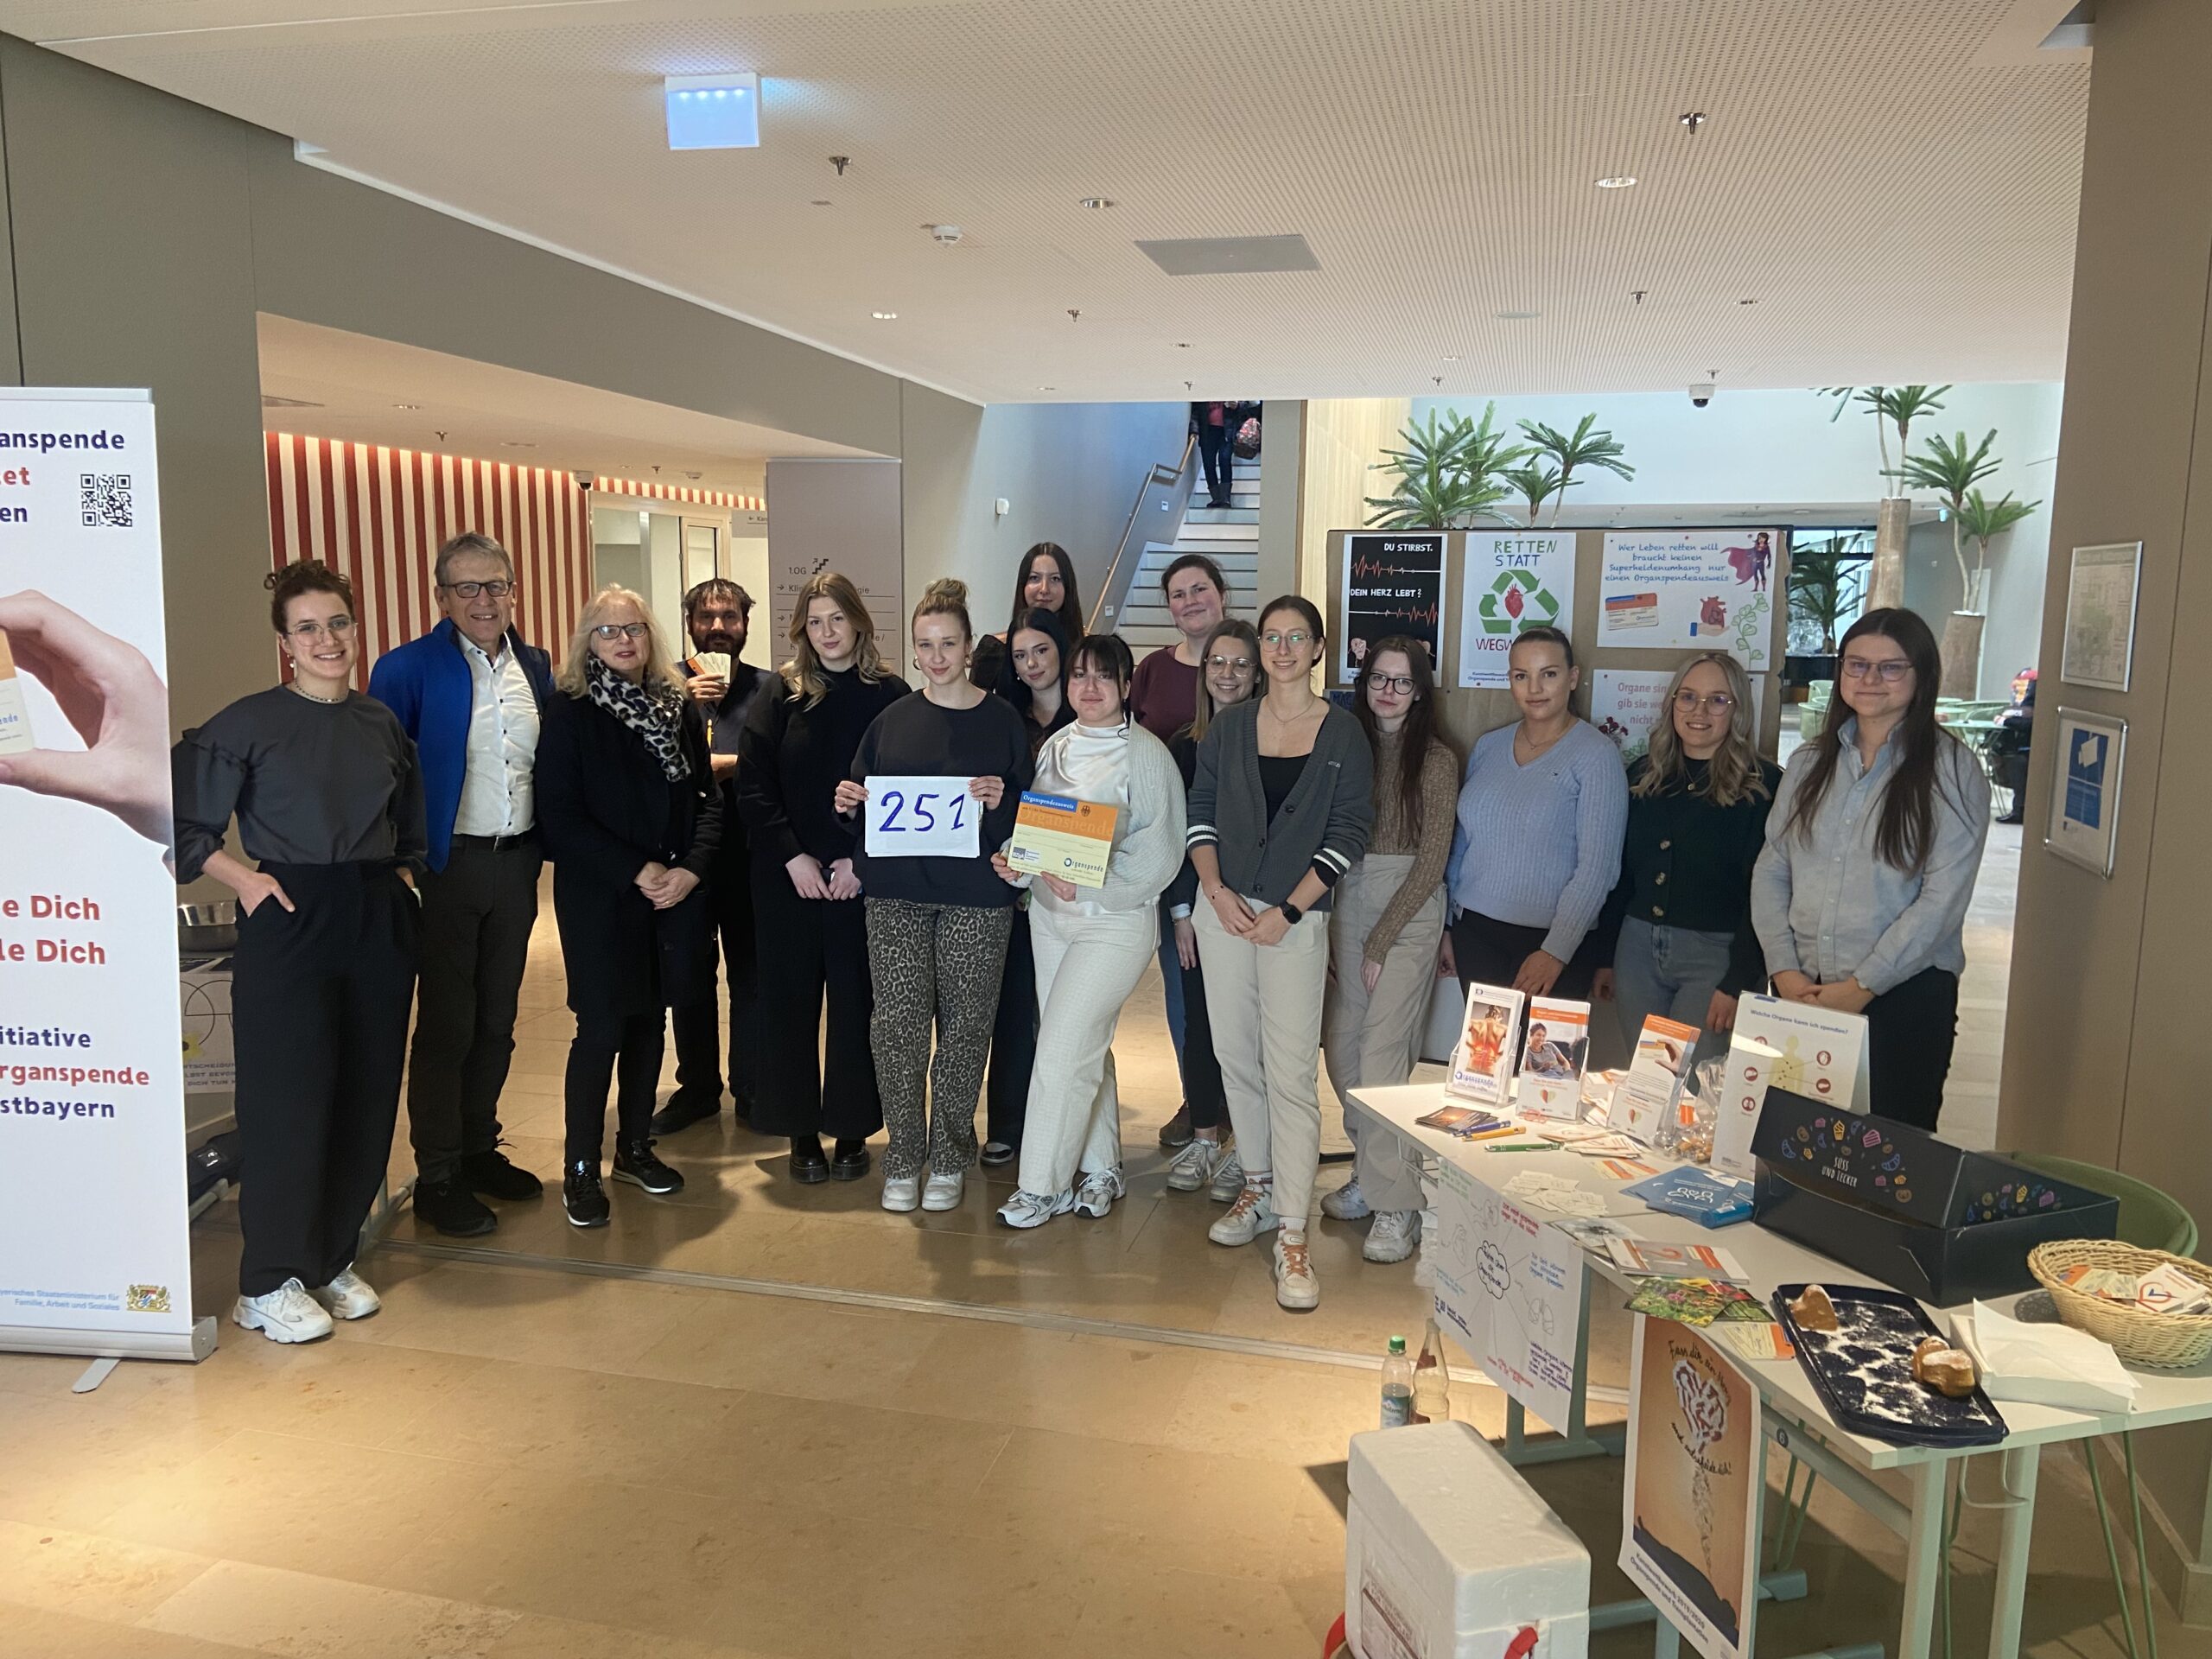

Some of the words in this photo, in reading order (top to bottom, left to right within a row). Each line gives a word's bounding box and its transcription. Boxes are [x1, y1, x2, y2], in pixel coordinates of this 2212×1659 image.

[0, 467, 30, 486] et
[1384, 543, 1395, 551] DU
[1396, 543, 1433, 552] STIRBST.
[1494, 540, 1557, 554] RETTEN
[1638, 543, 1665, 551] Leben
[1700, 543, 1719, 551] will
[1495, 554, 1541, 567] STATT
[1609, 563, 1700, 575] Superheldenumhang
[1634, 574, 1729, 584] Organspendeausweis
[1618, 683, 1651, 695] Organe
[1617, 699, 1632, 710] gib
[1634, 699, 1648, 709] sie
[1630, 714, 1654, 725] nicht
[1023, 794, 1075, 810] Organspendeausweis
[879, 791, 965, 832] 251
[30, 895, 100, 920] Dich
[36, 939, 105, 964] Dich
[0, 1065, 149, 1086] rganspende
[0, 1096, 115, 1121] stbayern
[1821, 1166, 1835, 1179] UND
